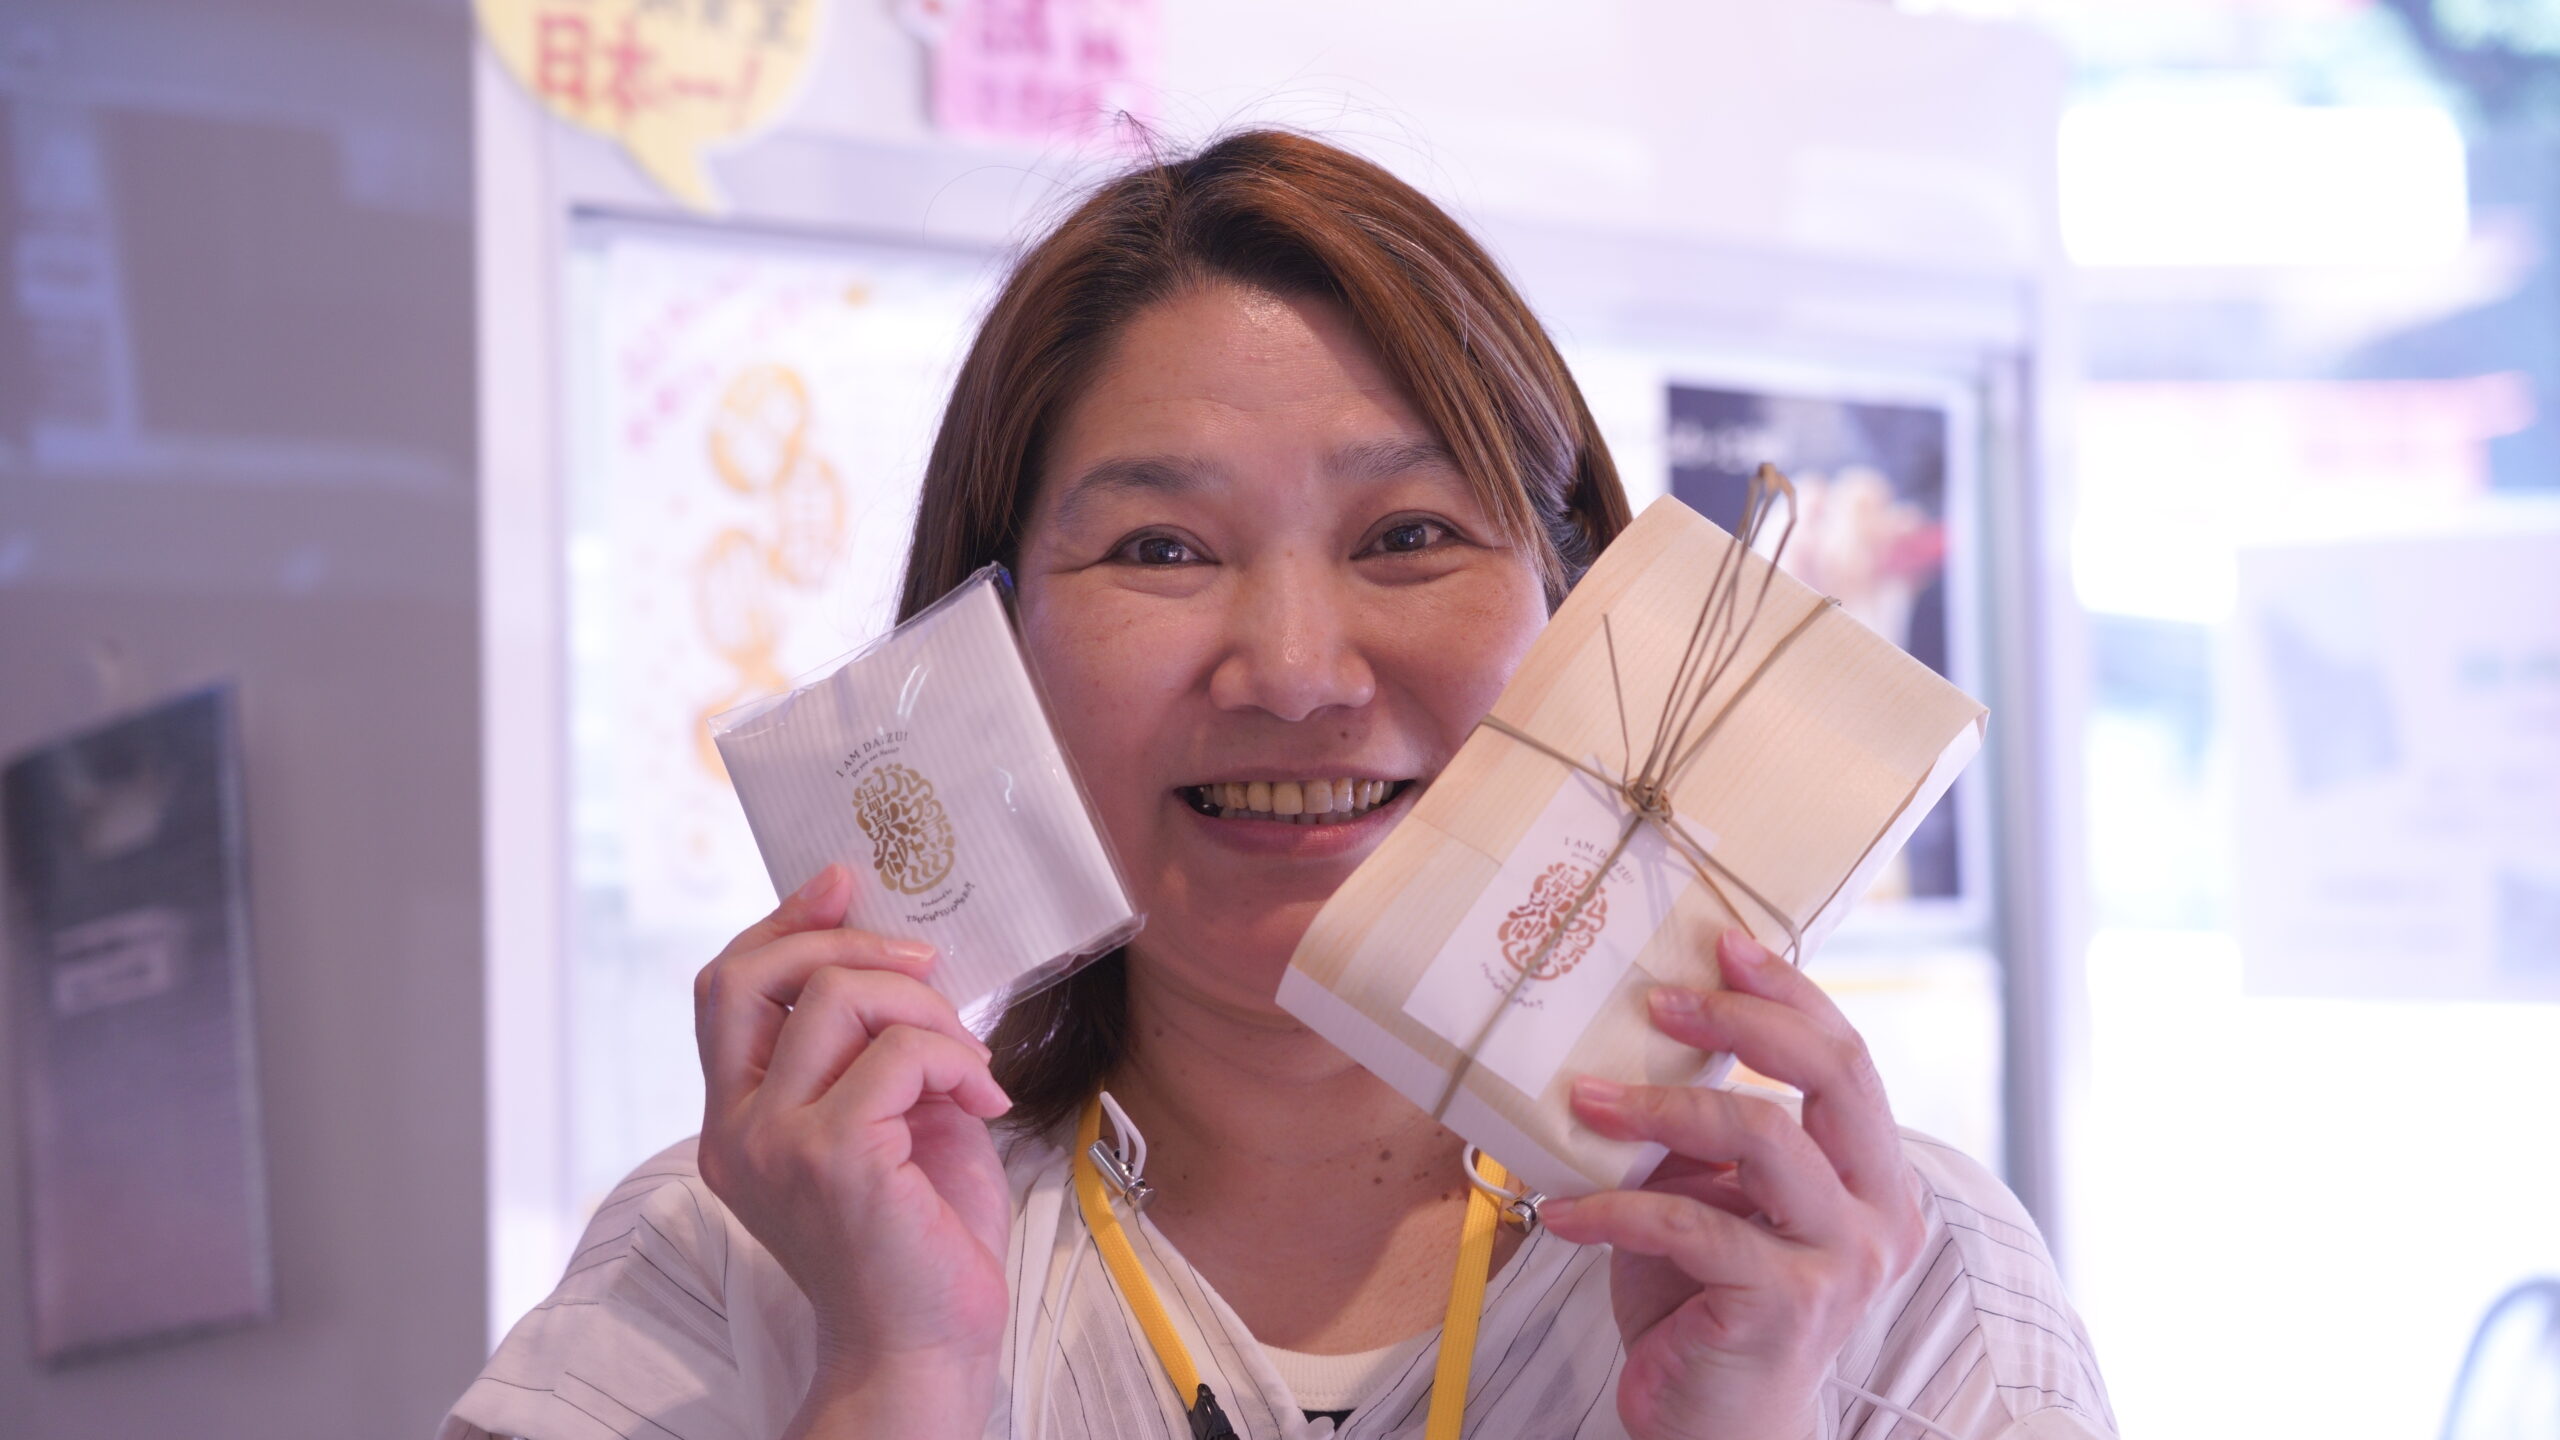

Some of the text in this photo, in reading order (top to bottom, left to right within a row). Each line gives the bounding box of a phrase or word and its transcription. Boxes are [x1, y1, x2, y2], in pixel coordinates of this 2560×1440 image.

[835, 769, 844, 778] I
[843, 749, 861, 770] AM
[1575, 839, 1595, 853] AM
